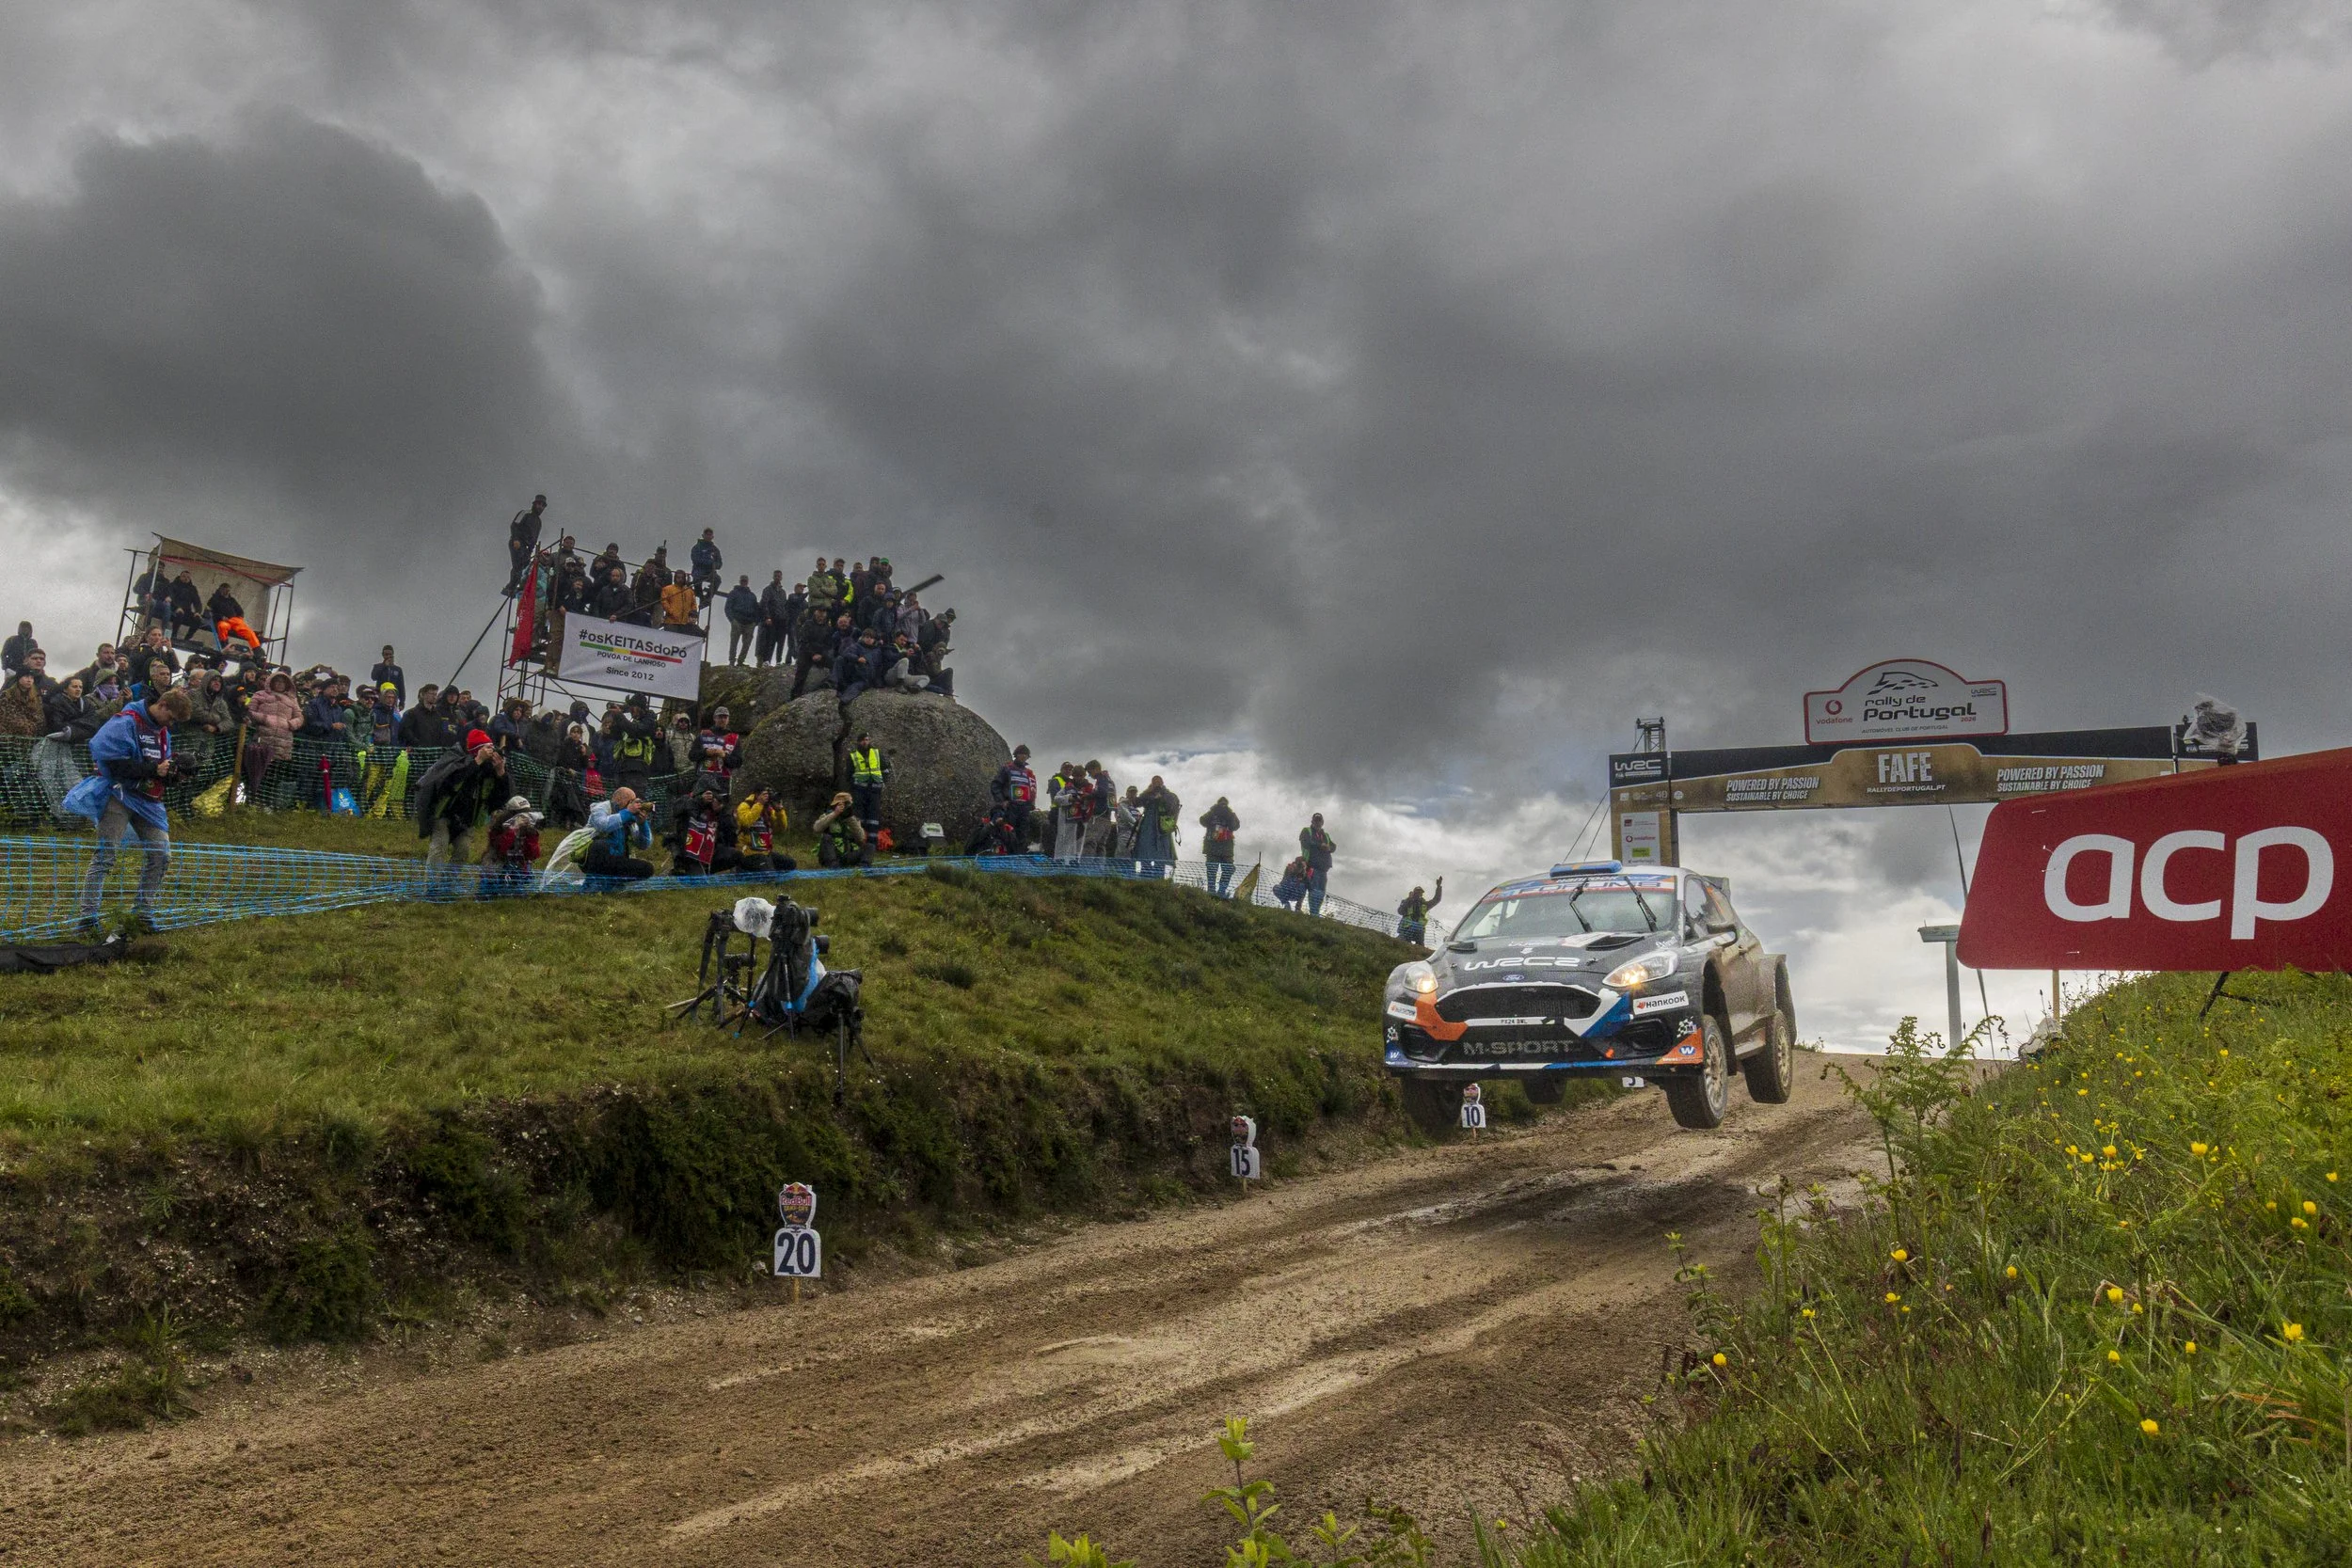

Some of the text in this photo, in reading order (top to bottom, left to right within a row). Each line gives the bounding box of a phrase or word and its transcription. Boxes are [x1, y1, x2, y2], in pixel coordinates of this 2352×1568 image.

[579, 628, 688, 658] #osKEITASdoPó
[633, 657, 666, 669] LANHOSO
[606, 666, 655, 681] Since 2012
[1865, 695, 1926, 707] rally de
[1863, 703, 1977, 721] Portugal
[1816, 717, 1853, 725] vodafone
[1614, 759, 1661, 771] WRC
[1878, 752, 1932, 784] FAFE
[1996, 765, 2105, 782] POWERED BY PASSION
[1726, 777, 1820, 792] POWERED BY PASSION
[1867, 784, 1946, 793] RALLYDEPORTUGAL.PT
[1996, 779, 2092, 793] SUSTAINABLE BY CHOICE
[1726, 791, 1808, 801] SUSTAINABLE BY CHOICE
[2043, 826, 2334, 940] acp
[1464, 957, 1581, 972] WRC2
[1390, 1051, 1400, 1059] W
[1680, 1046, 1694, 1054] W
[1464, 1106, 1481, 1126] 10
[1232, 1148, 1250, 1176] 15
[781, 1196, 812, 1205] Red Bull
[776, 1231, 816, 1275] 20
